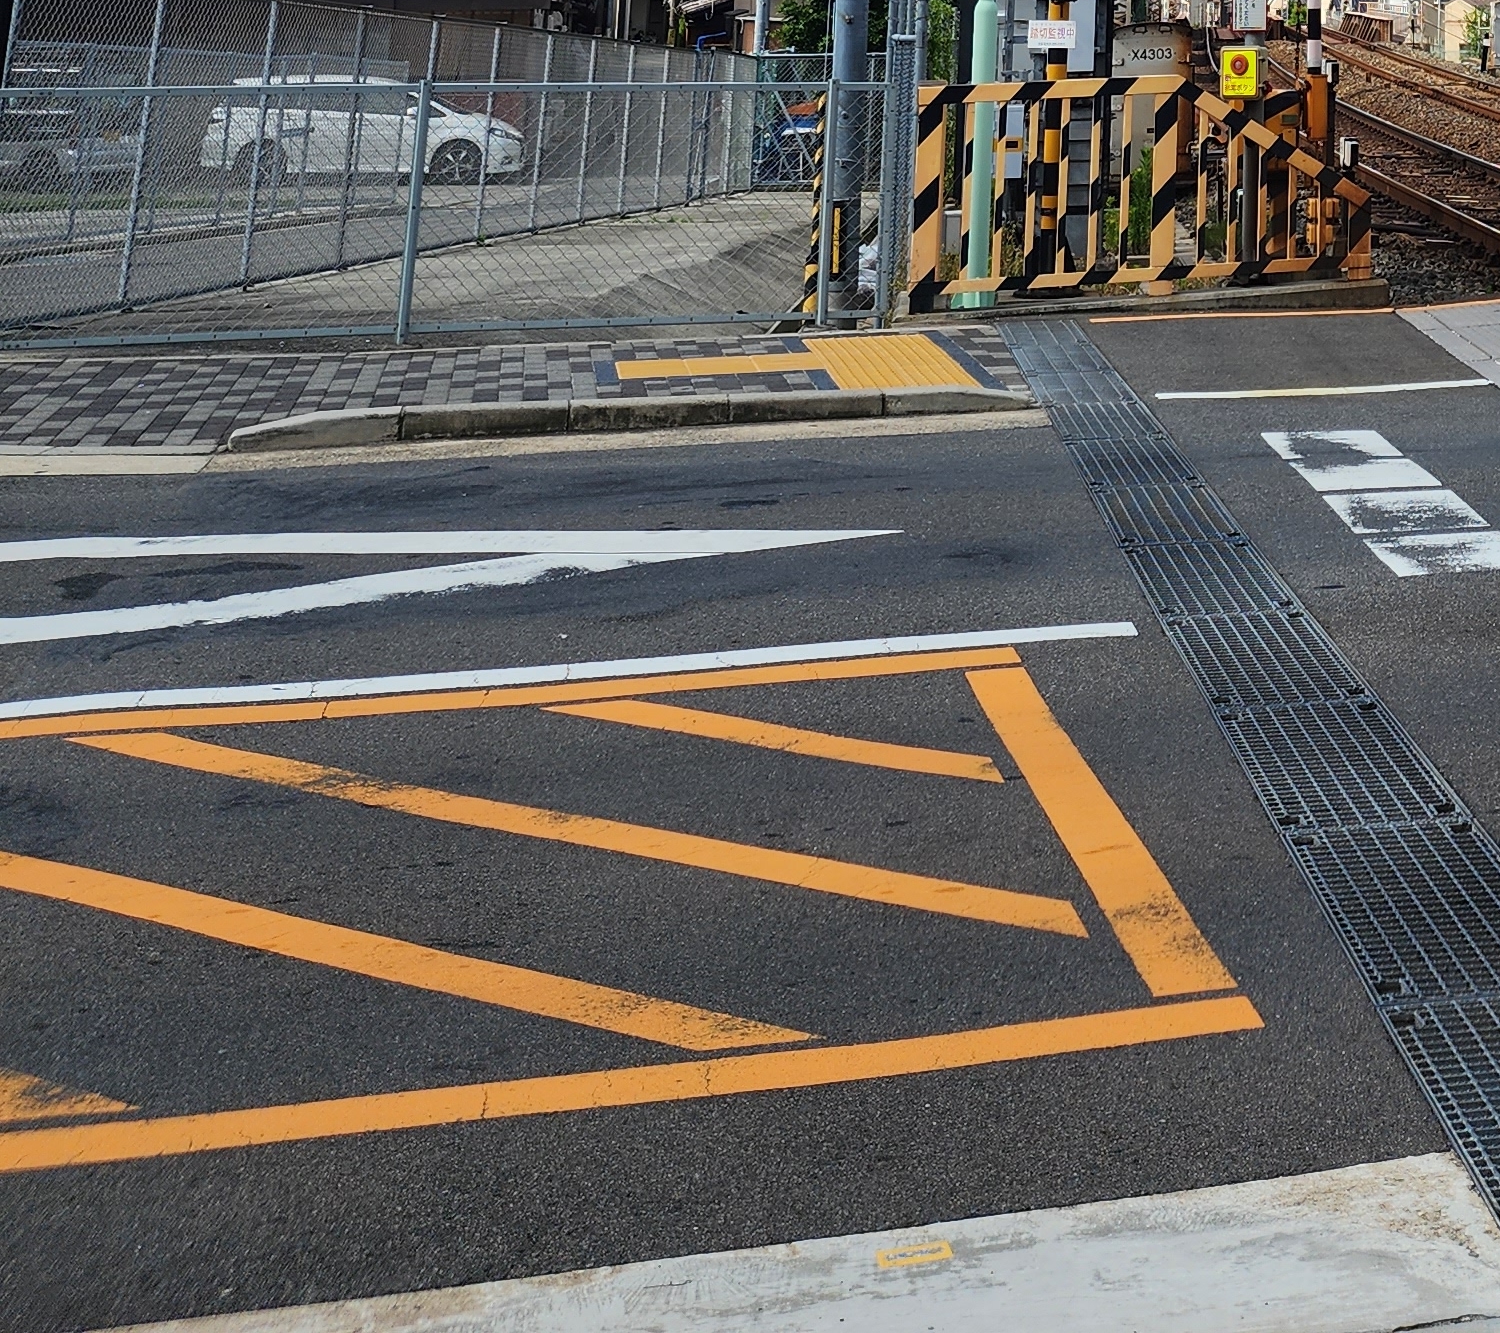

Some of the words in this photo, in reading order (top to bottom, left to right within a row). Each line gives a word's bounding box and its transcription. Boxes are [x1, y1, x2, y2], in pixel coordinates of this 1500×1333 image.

[1030, 27, 1075, 40] 踏切監視中
[1131, 47, 1173, 61] X4303
